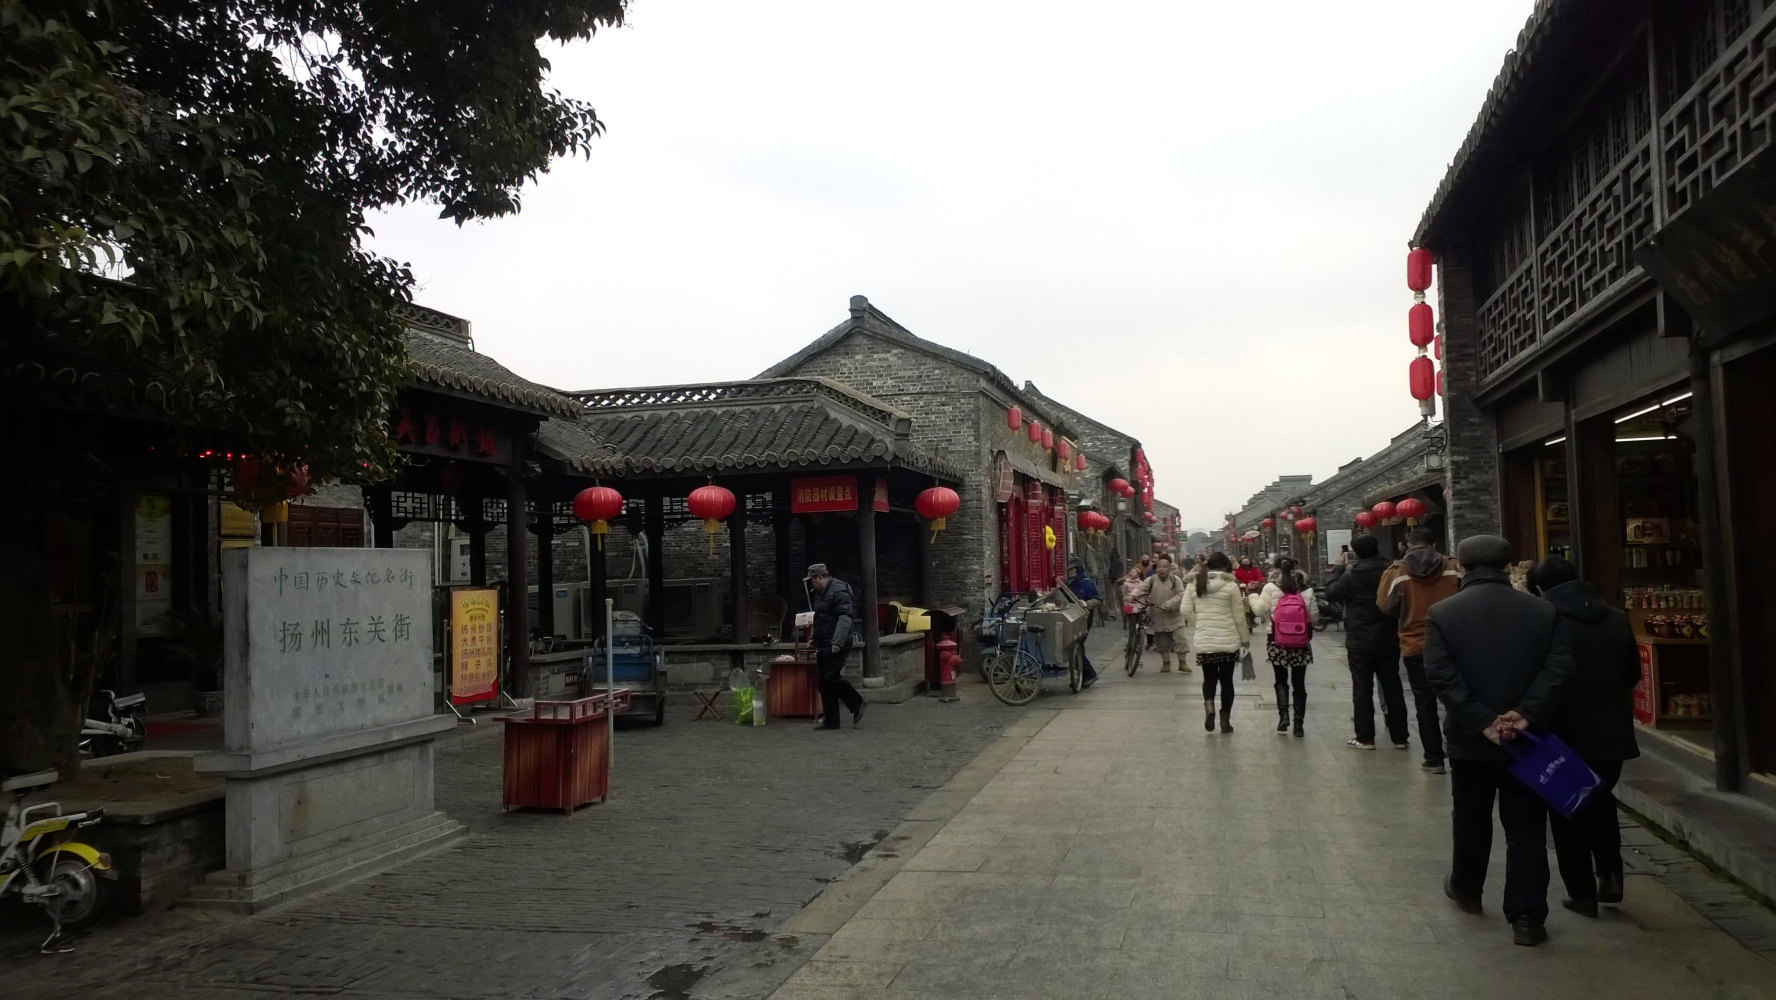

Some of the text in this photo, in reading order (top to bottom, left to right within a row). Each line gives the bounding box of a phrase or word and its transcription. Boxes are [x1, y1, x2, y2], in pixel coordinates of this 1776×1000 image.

[796, 485, 852, 503] 消防器材设置点
[274, 567, 414, 596] 中国历史文化名街
[279, 613, 411, 653] 扬州东关街
